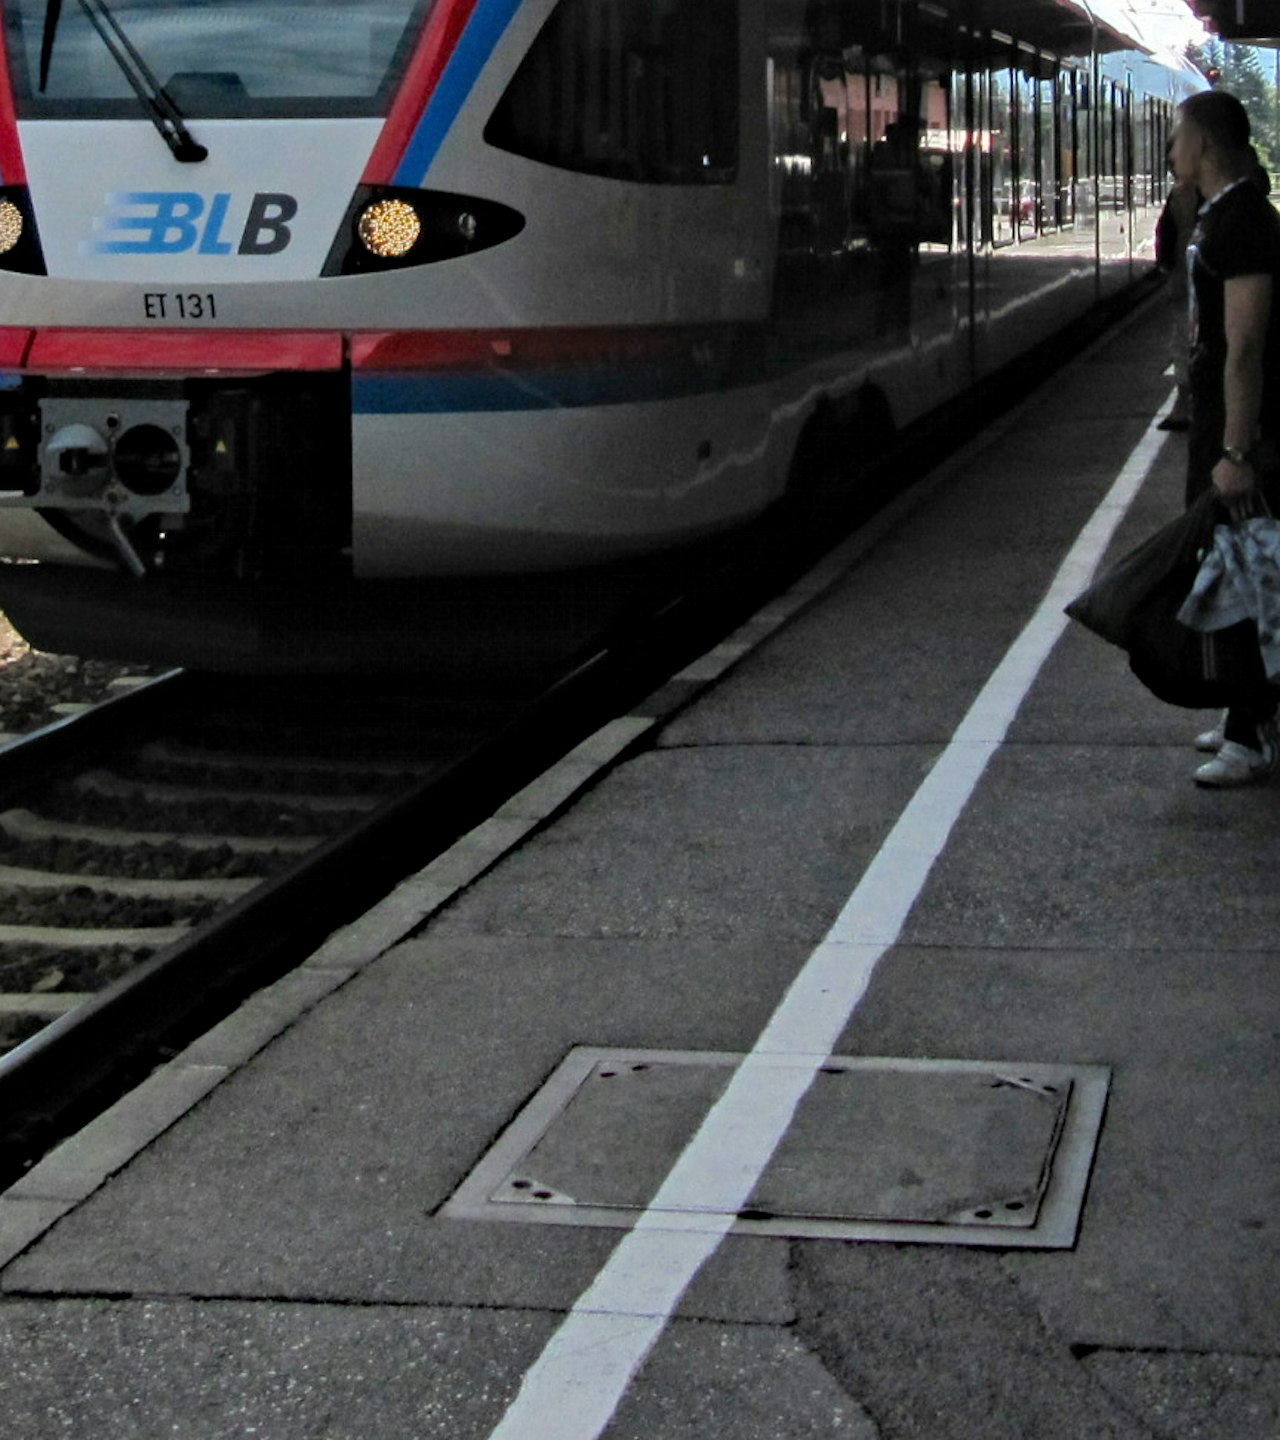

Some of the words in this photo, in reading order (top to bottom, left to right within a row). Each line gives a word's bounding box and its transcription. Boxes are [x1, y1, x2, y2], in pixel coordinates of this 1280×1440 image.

[100, 191, 299, 256] BLB
[144, 293, 167, 319] ET
[176, 293, 216, 319] 131
